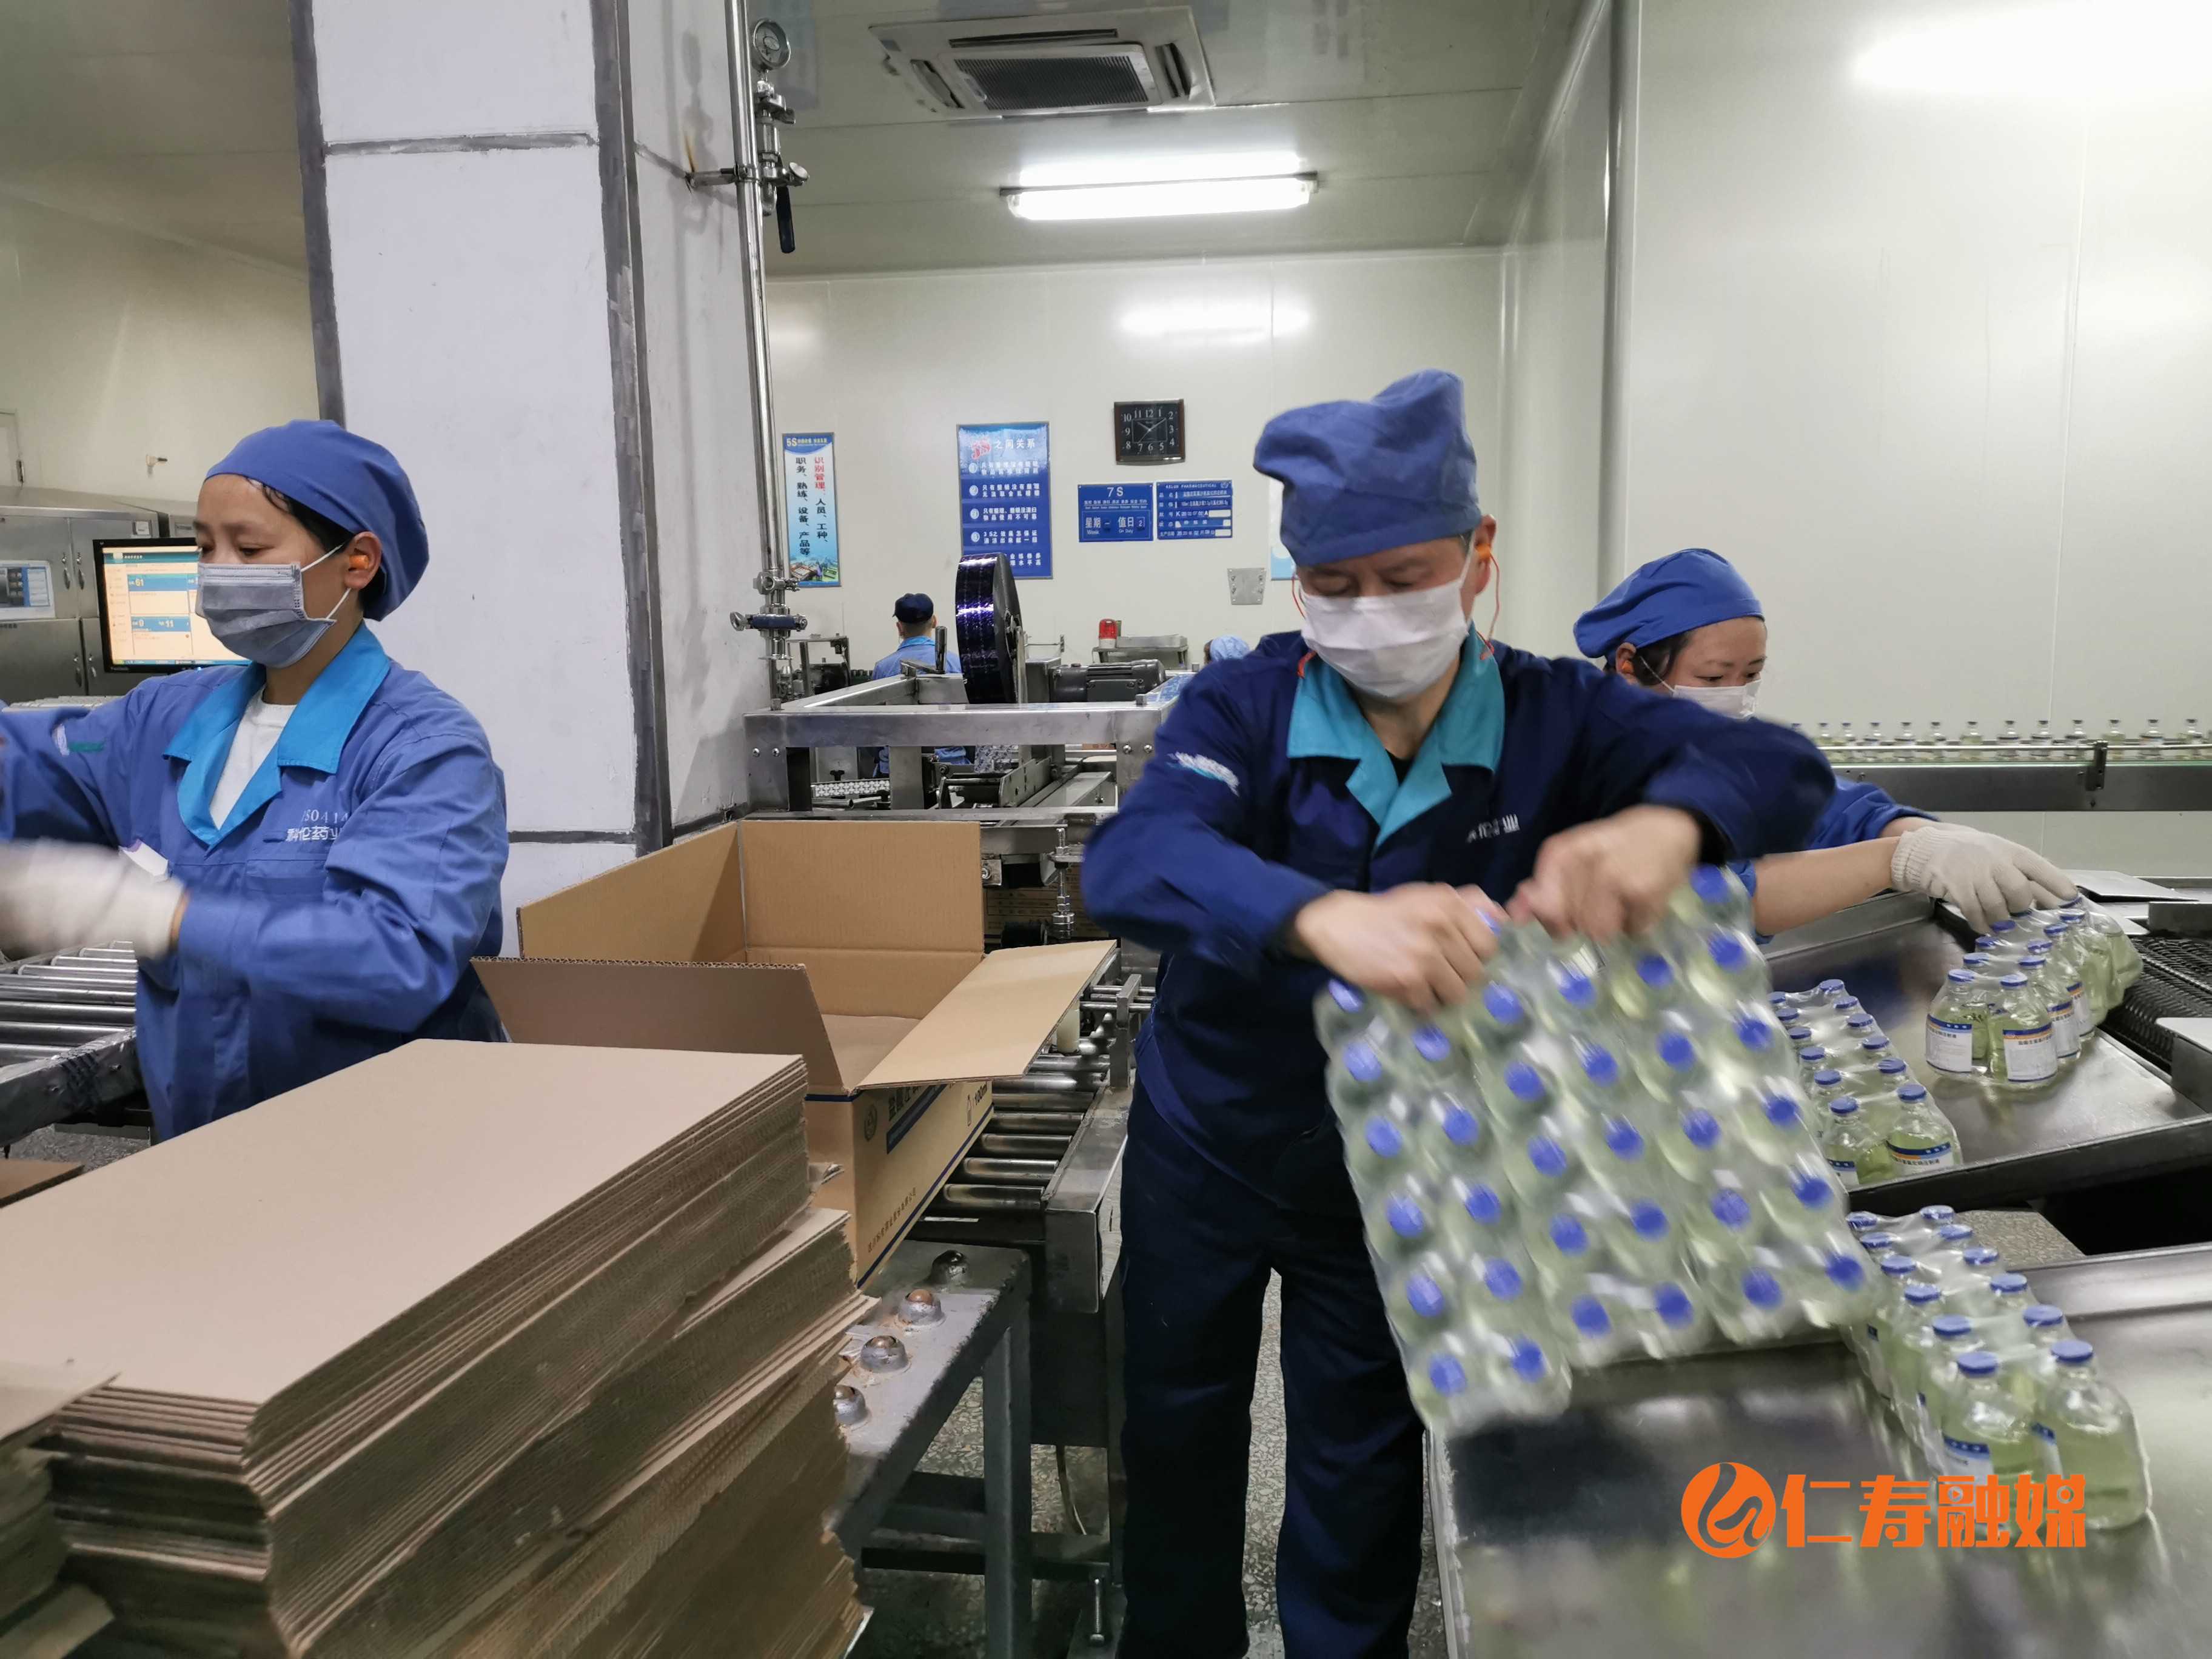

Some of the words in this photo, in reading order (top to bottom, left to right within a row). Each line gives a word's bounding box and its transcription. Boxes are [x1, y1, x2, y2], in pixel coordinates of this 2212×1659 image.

[1124, 413, 1131, 422] 10
[1134, 410, 1141, 418] 11
[1145, 409, 1153, 418] 12
[1168, 411, 1173, 420] 2
[1125, 427, 1130, 436] 9
[1169, 425, 1174, 434] 3
[786, 437, 797, 447] 5S
[995, 438, 1035, 449] 之间关系
[1126, 441, 1131, 450] 8
[1159, 442, 1164, 451] 5
[1170, 437, 1175, 447] 4
[1139, 443, 1143, 452] 7
[1148, 443, 1153, 451] 6
[1107, 487, 1123, 497] 7S
[1085, 517, 1101, 528] 星期
[1118, 517, 1134, 528] 值日
